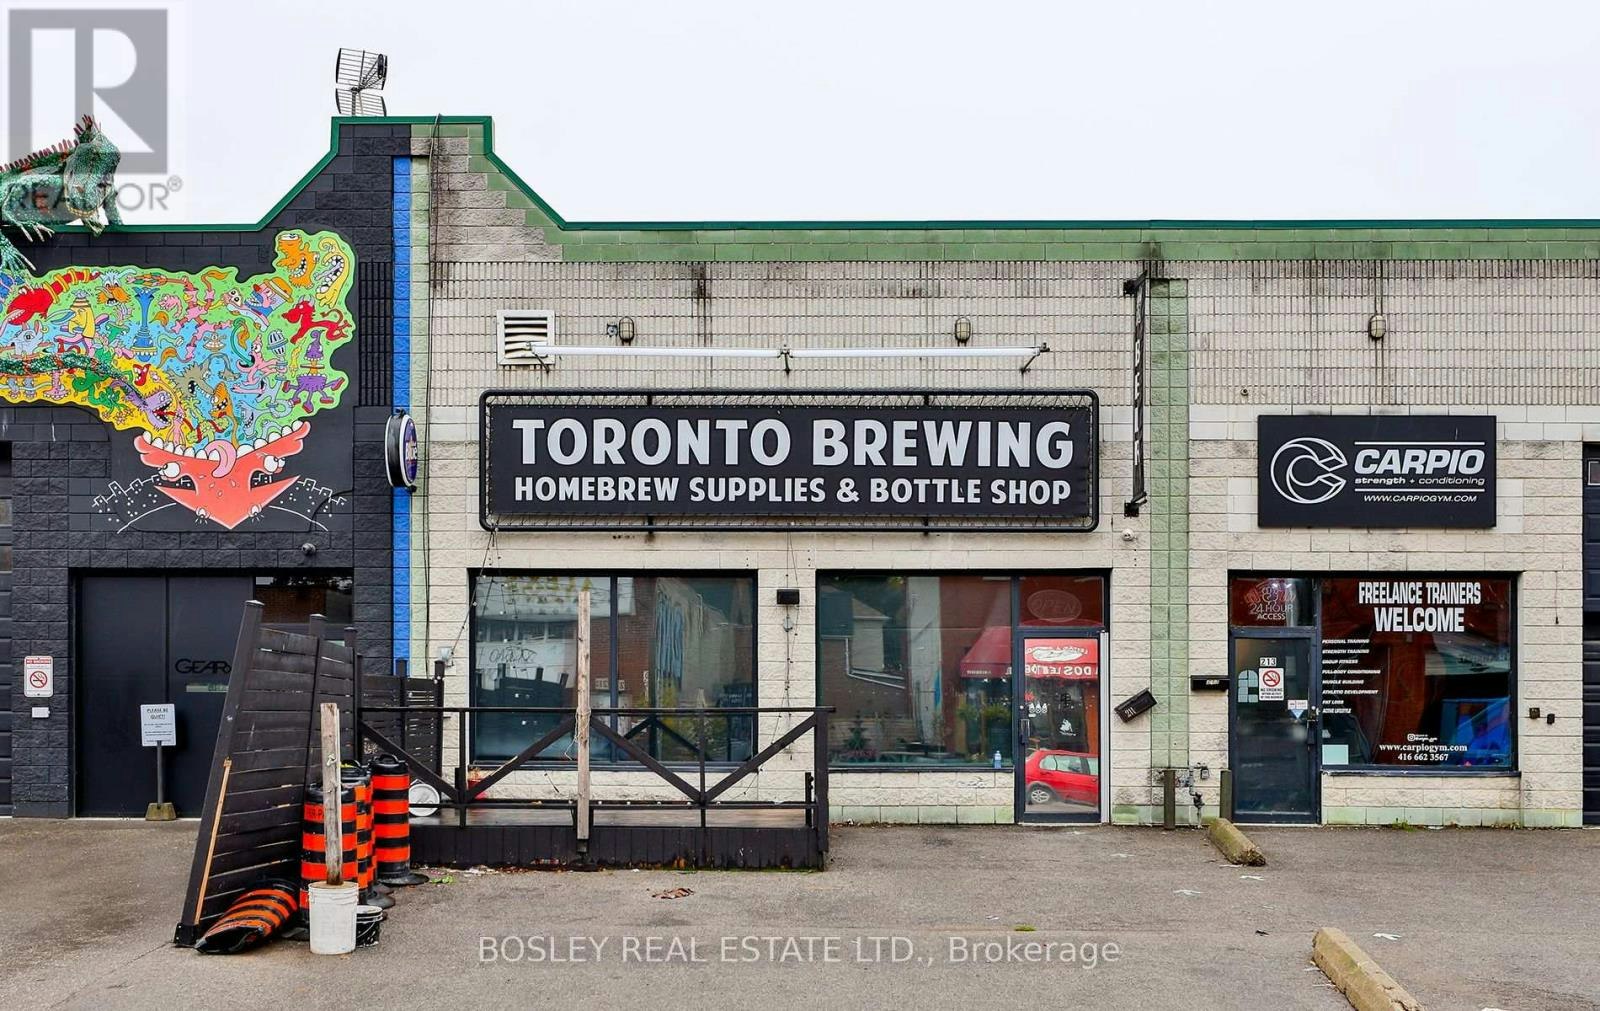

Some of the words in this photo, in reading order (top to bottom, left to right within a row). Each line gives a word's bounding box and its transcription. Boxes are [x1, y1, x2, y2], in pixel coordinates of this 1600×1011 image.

[512, 418, 791, 466] TORONTO
[812, 419, 1074, 469] BREWING
[1354, 449, 1486, 475] CARPIO
[514, 477, 679, 501] HOMEBREW
[689, 477, 826, 503] SUPPLIES
[836, 478, 860, 502] &
[870, 478, 981, 503] BOTTLE
[990, 479, 1071, 504] SHOP
[1354, 477, 1406, 485] strength
[1418, 477, 1486, 486] conditioning
[1364, 495, 1477, 503] WWW.CARPIOGYM.COM
[1358, 581, 1423, 605] FREELANCE
[1426, 582, 1482, 605] TRAINERS
[1249, 603, 1263, 615] 24
[1265, 603, 1294, 613] HOUR
[1374, 607, 1465, 633] WELCOME
[1379, 743, 1468, 753] www.carpiogym.com
[1397, 753, 1412, 761] 416
[1413, 753, 1428, 761] 662
[1430, 753, 1449, 761] 3567
